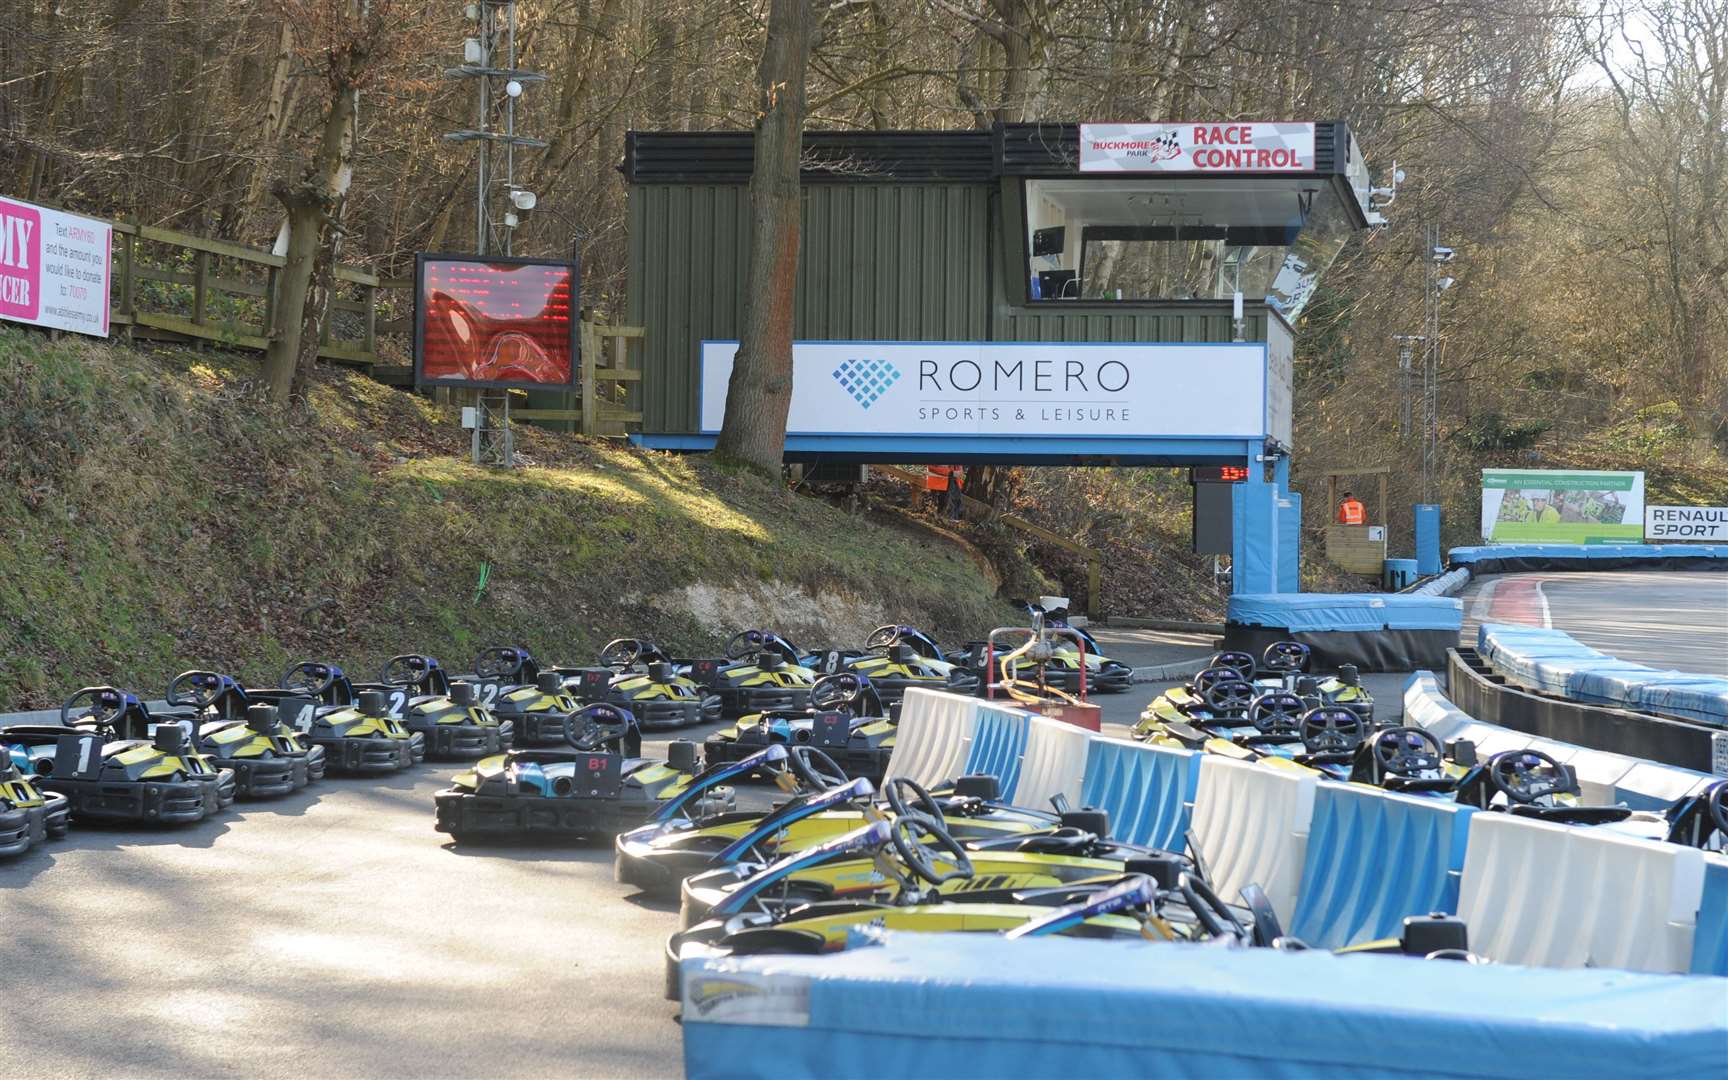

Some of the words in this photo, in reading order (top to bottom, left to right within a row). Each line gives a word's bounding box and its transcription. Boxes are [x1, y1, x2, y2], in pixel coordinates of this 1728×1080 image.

[1092, 141, 1149, 150] BUCKMORE
[1193, 126, 1252, 145] RACE
[1192, 148, 1303, 168] CONTROL
[55, 222, 68, 238] Text
[45, 243, 58, 256] and
[58, 244, 68, 258] the
[69, 249, 91, 263] amount
[91, 254, 103, 267] you
[45, 263, 64, 276] would
[64, 264, 74, 278] like
[75, 268, 82, 280] to
[83, 271, 101, 284] donate
[0, 273, 30, 306] CER
[919, 359, 1130, 392] ROMERO
[919, 407, 1000, 420] SPORTS
[1015, 408, 1025, 421] &
[1041, 408, 1129, 421] LEISURE
[1376, 530, 1383, 540] 1
[1652, 524, 1720, 536] SPORT
[826, 651, 839, 673] 8
[388, 692, 406, 719] 2
[294, 704, 316, 735] 4
[77, 736, 94, 773] 1
[588, 758, 608, 770] B1
